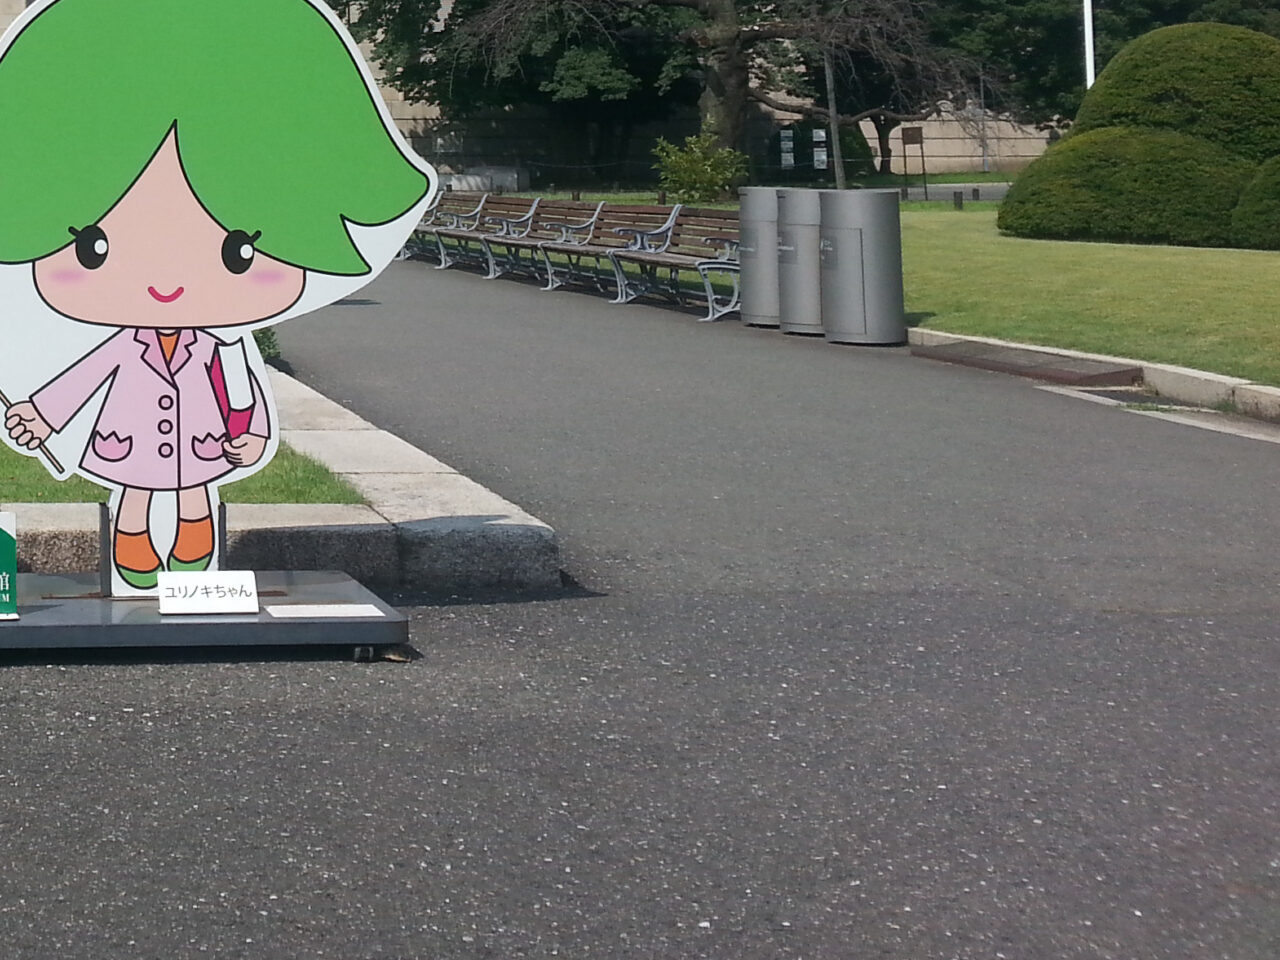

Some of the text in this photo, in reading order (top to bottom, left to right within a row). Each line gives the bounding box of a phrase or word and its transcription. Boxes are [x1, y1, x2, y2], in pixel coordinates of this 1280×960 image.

[164, 583, 253, 599] ユリノキちゃん
